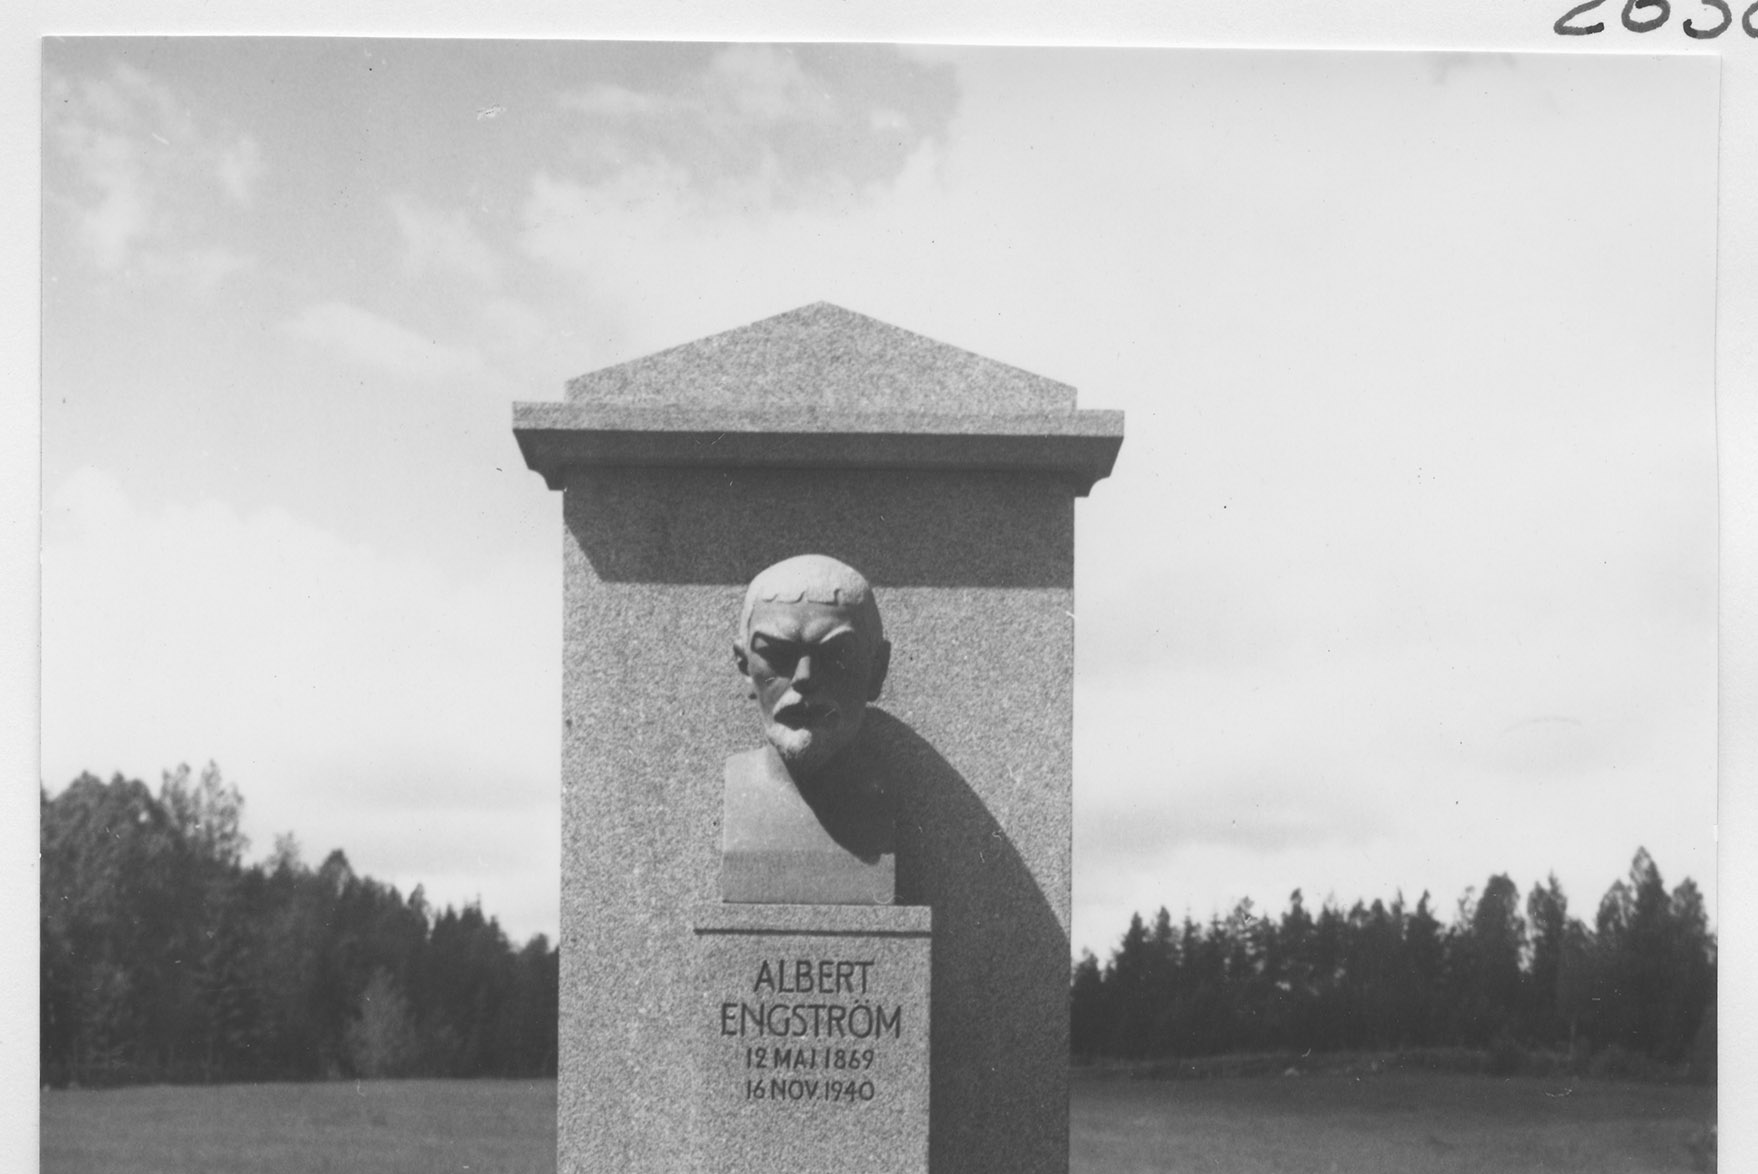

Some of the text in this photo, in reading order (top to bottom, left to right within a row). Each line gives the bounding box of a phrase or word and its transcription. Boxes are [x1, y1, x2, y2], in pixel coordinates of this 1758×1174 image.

[753, 959, 875, 994] ALBERT
[720, 999, 902, 1039] ENGSTRÖM
[746, 1047, 767, 1069] 12
[824, 1047, 875, 1070] 1869
[746, 1079, 766, 1100] 16
[824, 1080, 875, 1102] 1940
